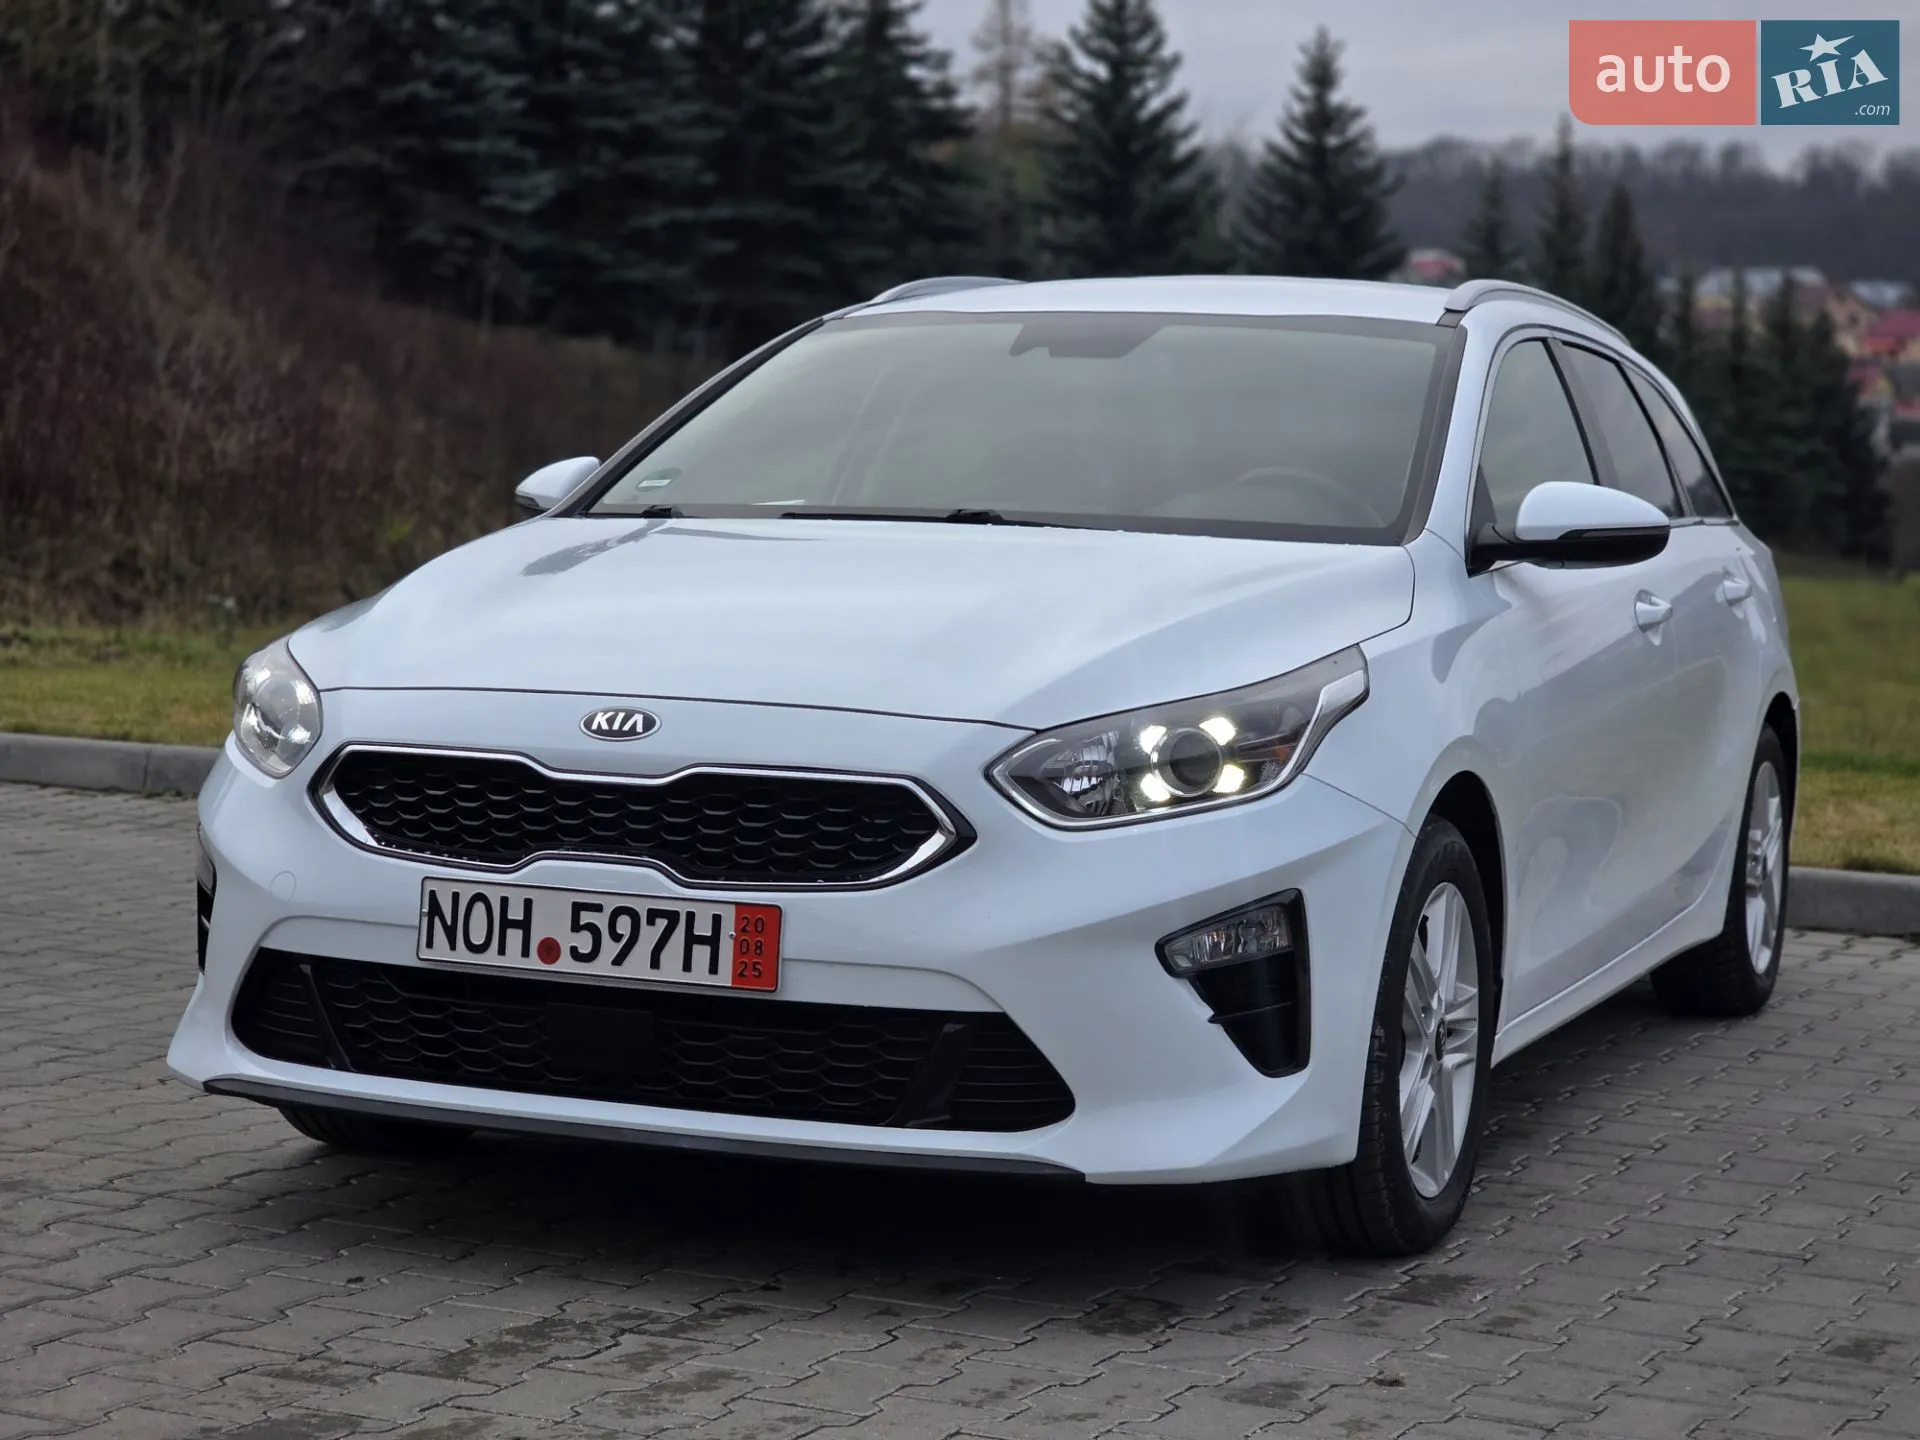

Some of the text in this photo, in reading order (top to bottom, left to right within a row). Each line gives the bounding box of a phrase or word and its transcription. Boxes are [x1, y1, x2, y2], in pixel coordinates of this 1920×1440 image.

[590, 711, 644, 733] KIA
[425, 889, 723, 976] NOH 597H
[740, 915, 766, 934] 20
[739, 937, 764, 956] 08
[737, 960, 763, 979] 25
